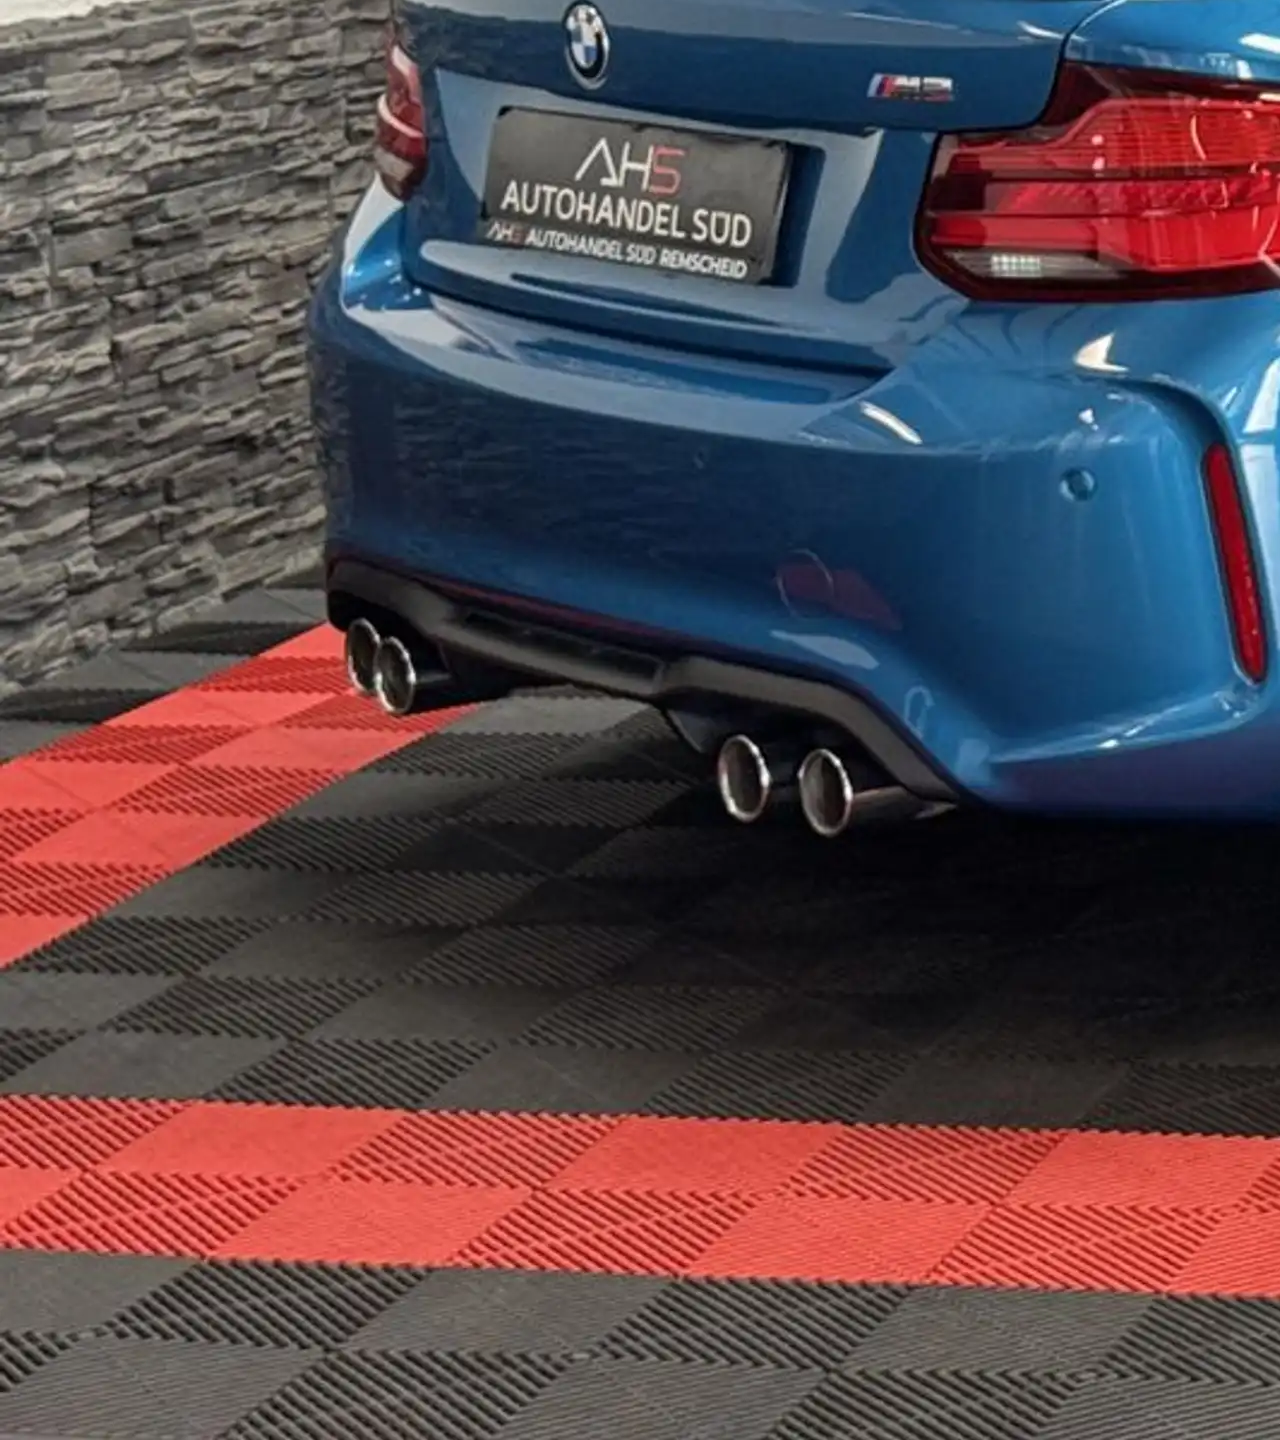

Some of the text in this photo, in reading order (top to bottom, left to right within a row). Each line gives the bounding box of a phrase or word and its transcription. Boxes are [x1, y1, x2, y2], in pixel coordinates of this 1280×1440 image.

[575, 137, 685, 196] AHS
[501, 180, 751, 248] AUTOHANDEL SÜD
[525, 231, 622, 261] AUTOHANDEL
[626, 245, 654, 266] SÜD
[660, 250, 747, 279] REMSCHEID
